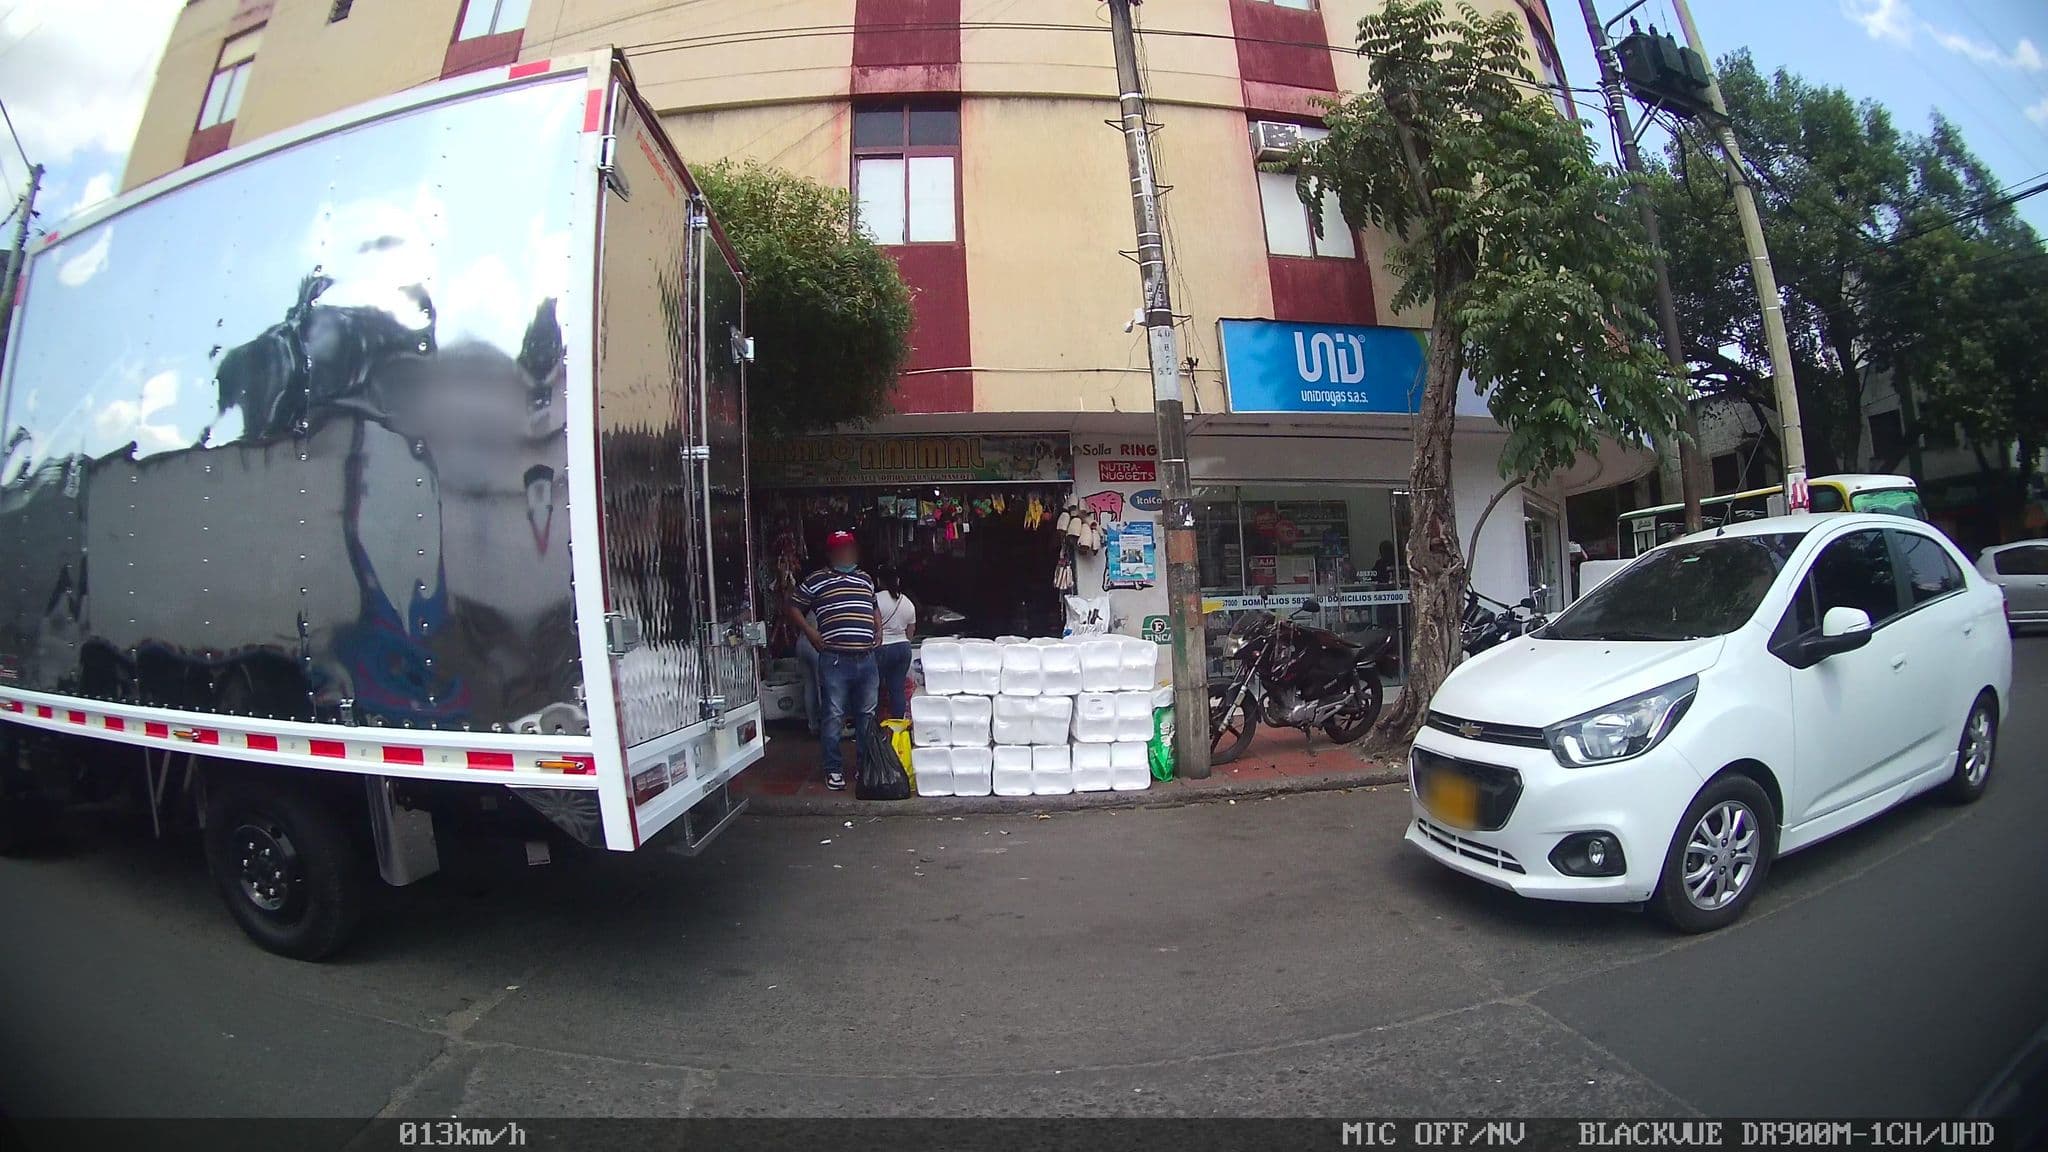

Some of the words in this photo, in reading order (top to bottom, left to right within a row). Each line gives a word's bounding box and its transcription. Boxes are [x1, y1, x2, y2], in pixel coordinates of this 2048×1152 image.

[859, 437, 985, 469] ANIMAL
[1082, 443, 1112, 456] Solla
[1101, 462, 1141, 472] NUTRA-
[1101, 471, 1155, 480] NUGGETS
[1242, 597, 1289, 607] DOMICILIOS
